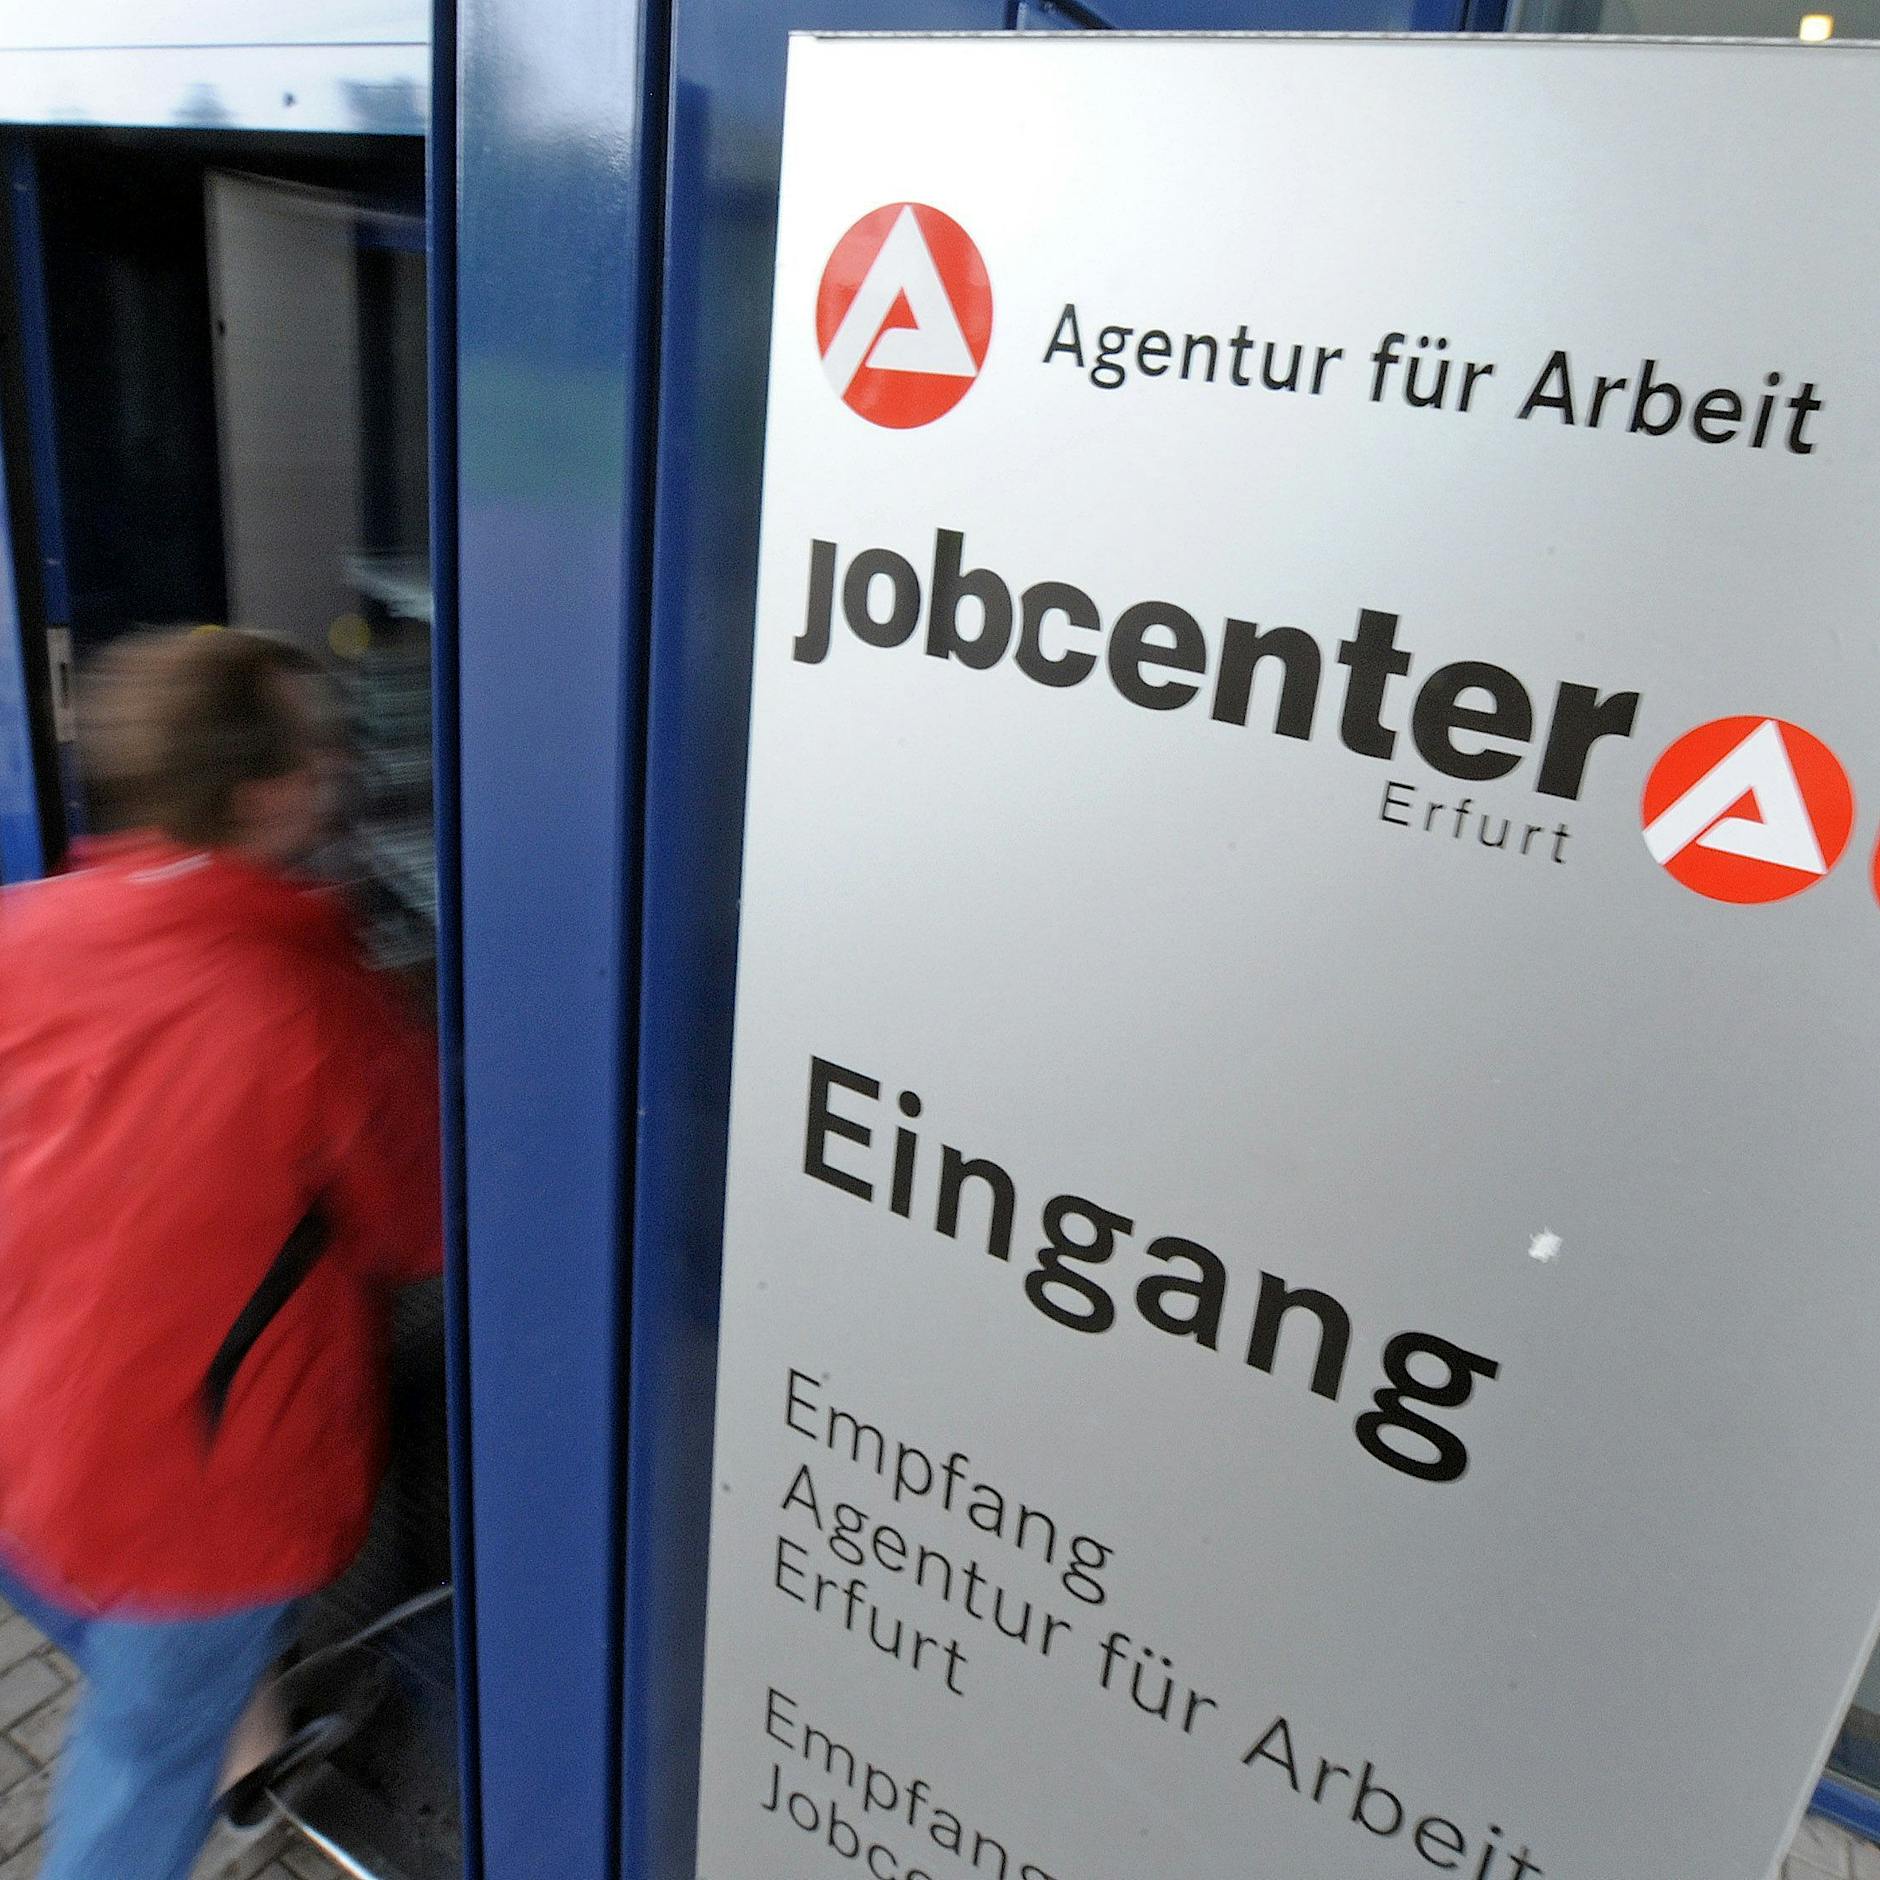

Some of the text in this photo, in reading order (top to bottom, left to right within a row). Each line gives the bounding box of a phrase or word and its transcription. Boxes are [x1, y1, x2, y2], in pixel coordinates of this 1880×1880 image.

[1043, 303, 1823, 455] Agentur für Arbeit
[1379, 780, 1572, 865] Erfurt
[803, 1055, 1502, 1485] Eingang
[785, 1367, 1115, 1606] Empfang
[775, 1535, 969, 1697] Erfurt
[780, 1463, 1073, 1657] Agentur
[1098, 1631, 1219, 1736] für
[761, 1762, 934, 1880] Jobc
[765, 1686, 1059, 1880] Empfan
